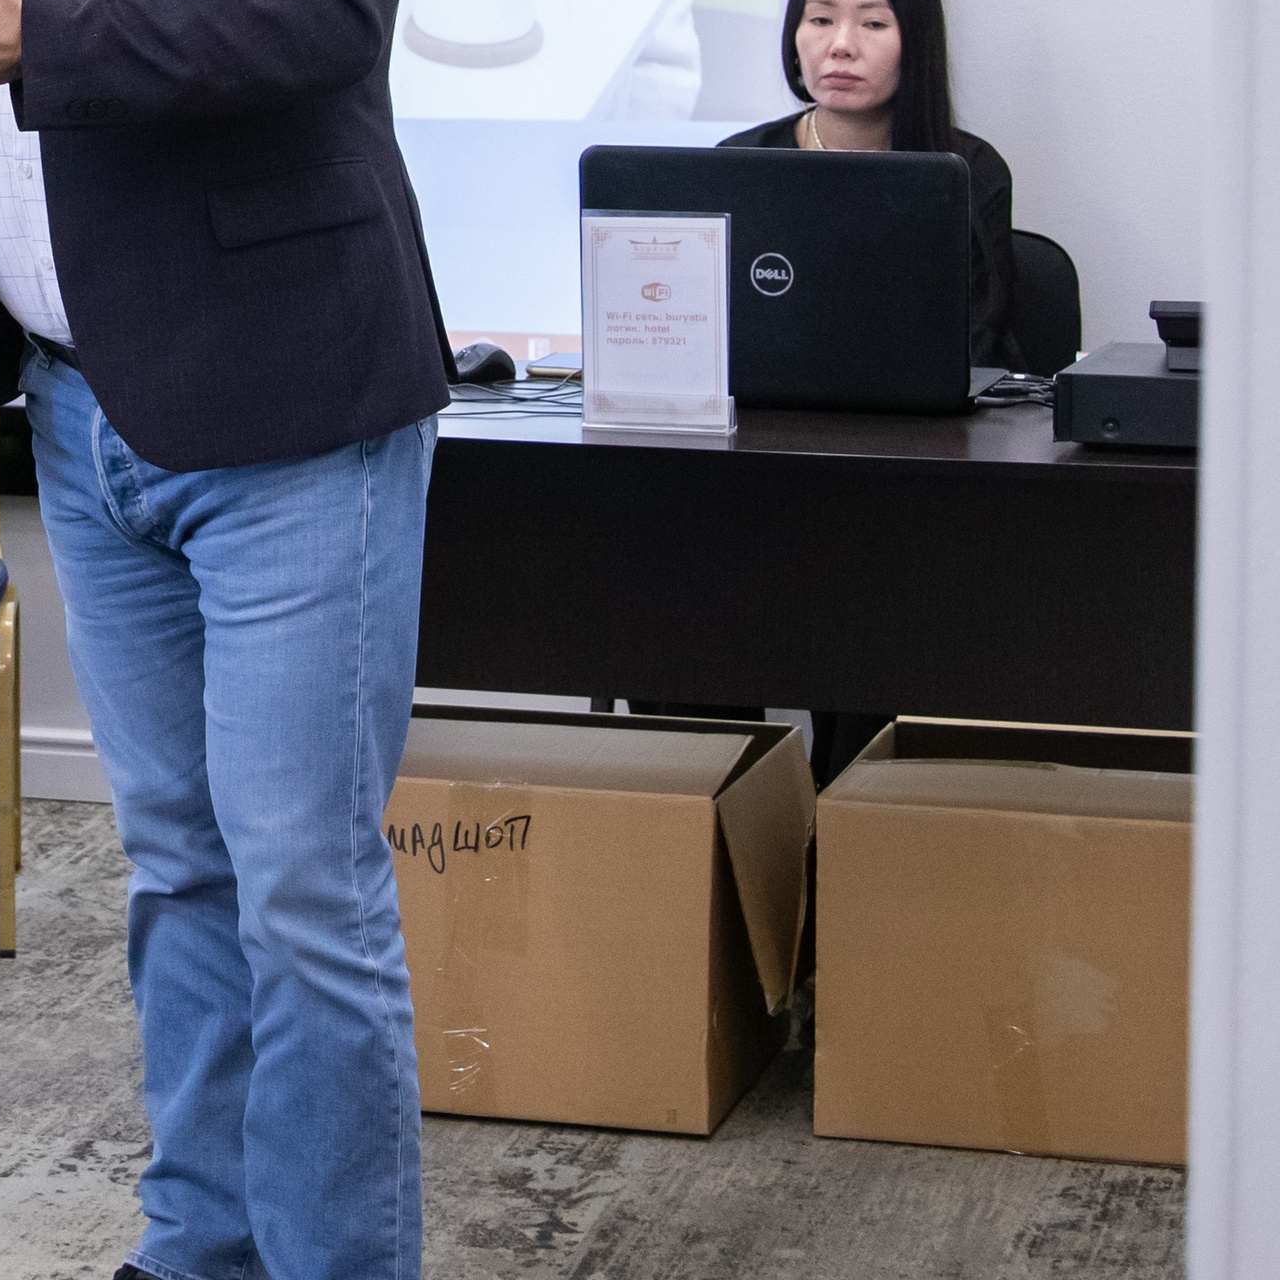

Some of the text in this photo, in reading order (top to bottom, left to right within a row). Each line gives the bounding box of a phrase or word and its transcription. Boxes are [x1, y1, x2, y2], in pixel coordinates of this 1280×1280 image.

[755, 268, 789, 280] DELL
[606, 311, 708, 323] Wi-Fi сеть: buryatia
[606, 324, 670, 333] логин: hotel
[606, 337, 687, 346] пароль: 879321
